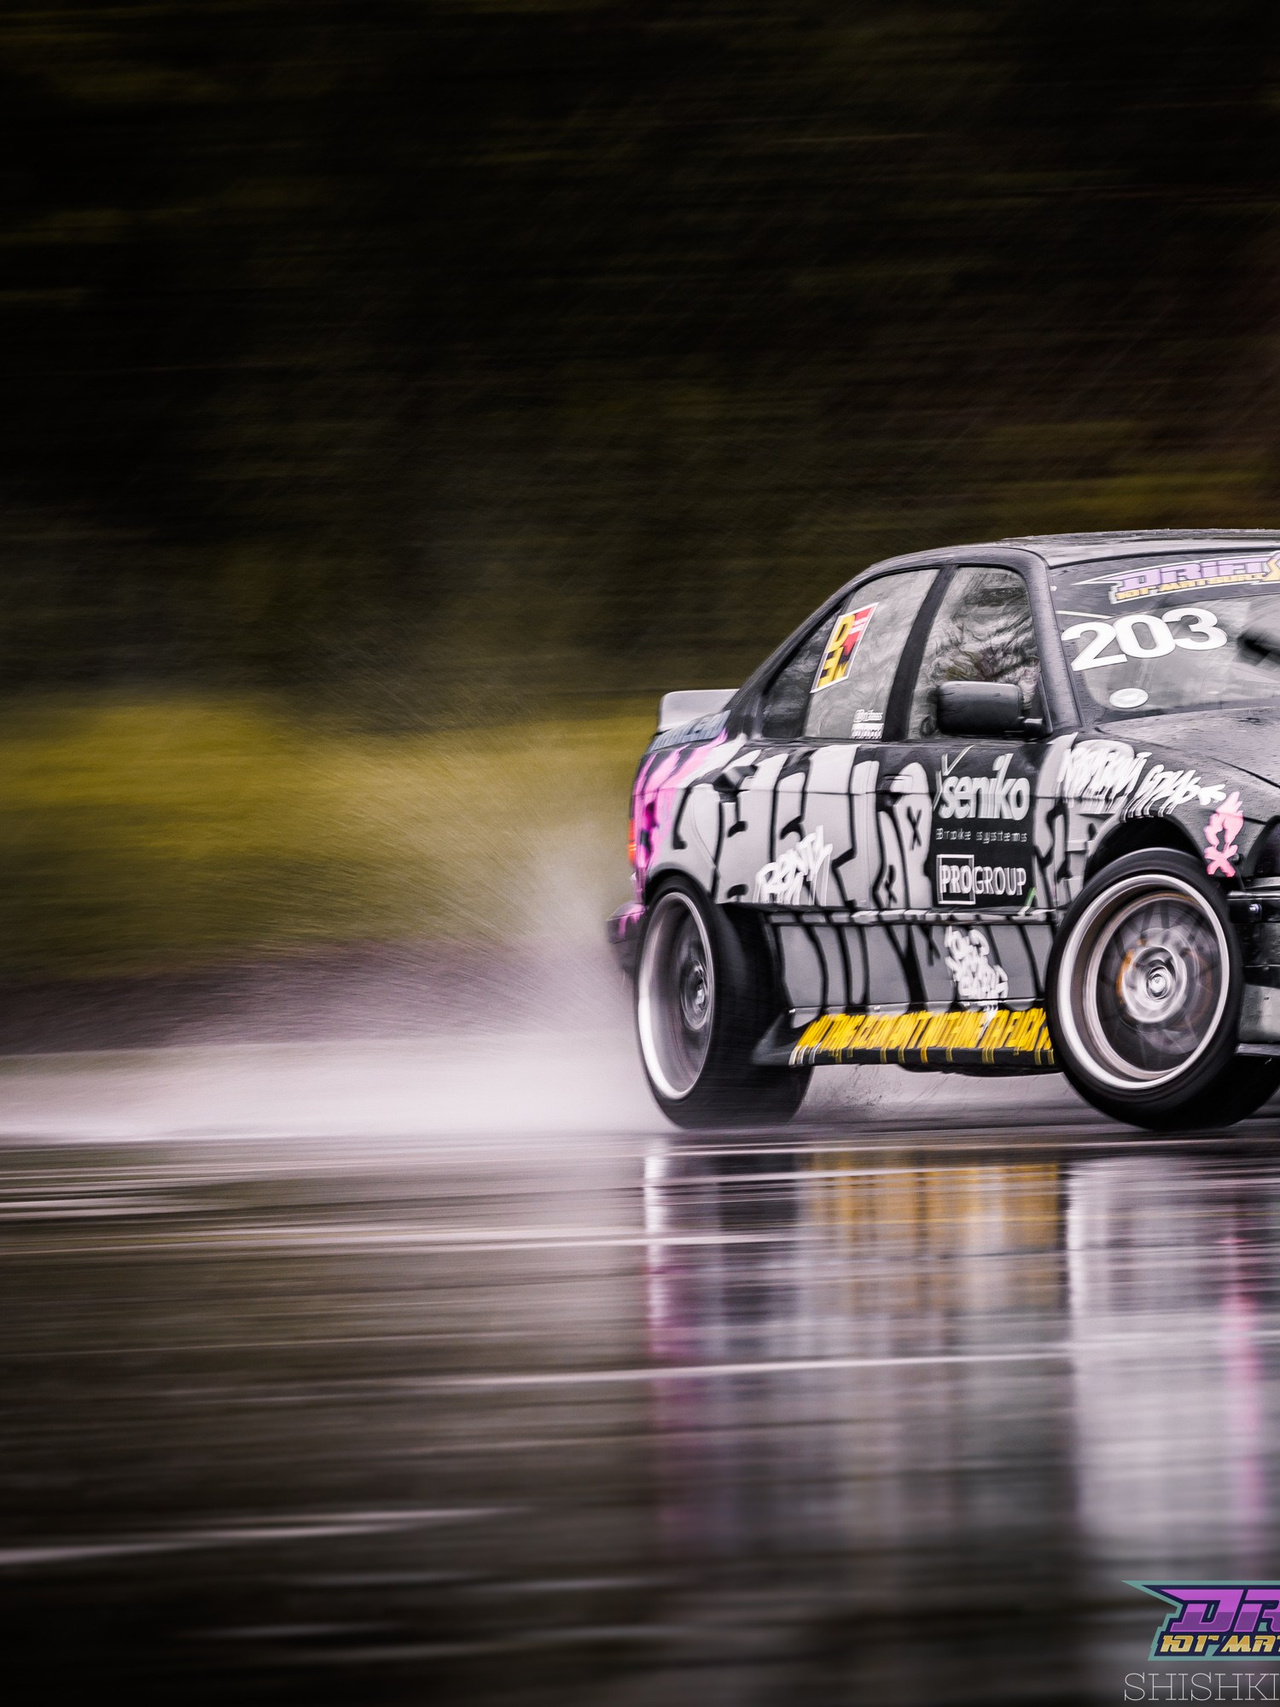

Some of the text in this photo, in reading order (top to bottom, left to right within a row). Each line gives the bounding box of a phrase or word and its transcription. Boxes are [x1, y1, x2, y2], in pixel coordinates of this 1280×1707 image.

[1100, 557, 1274, 590] DRIFT
[1061, 608, 1227, 671] 203
[938, 753, 1030, 820] seniko
[976, 829, 1028, 845] systems
